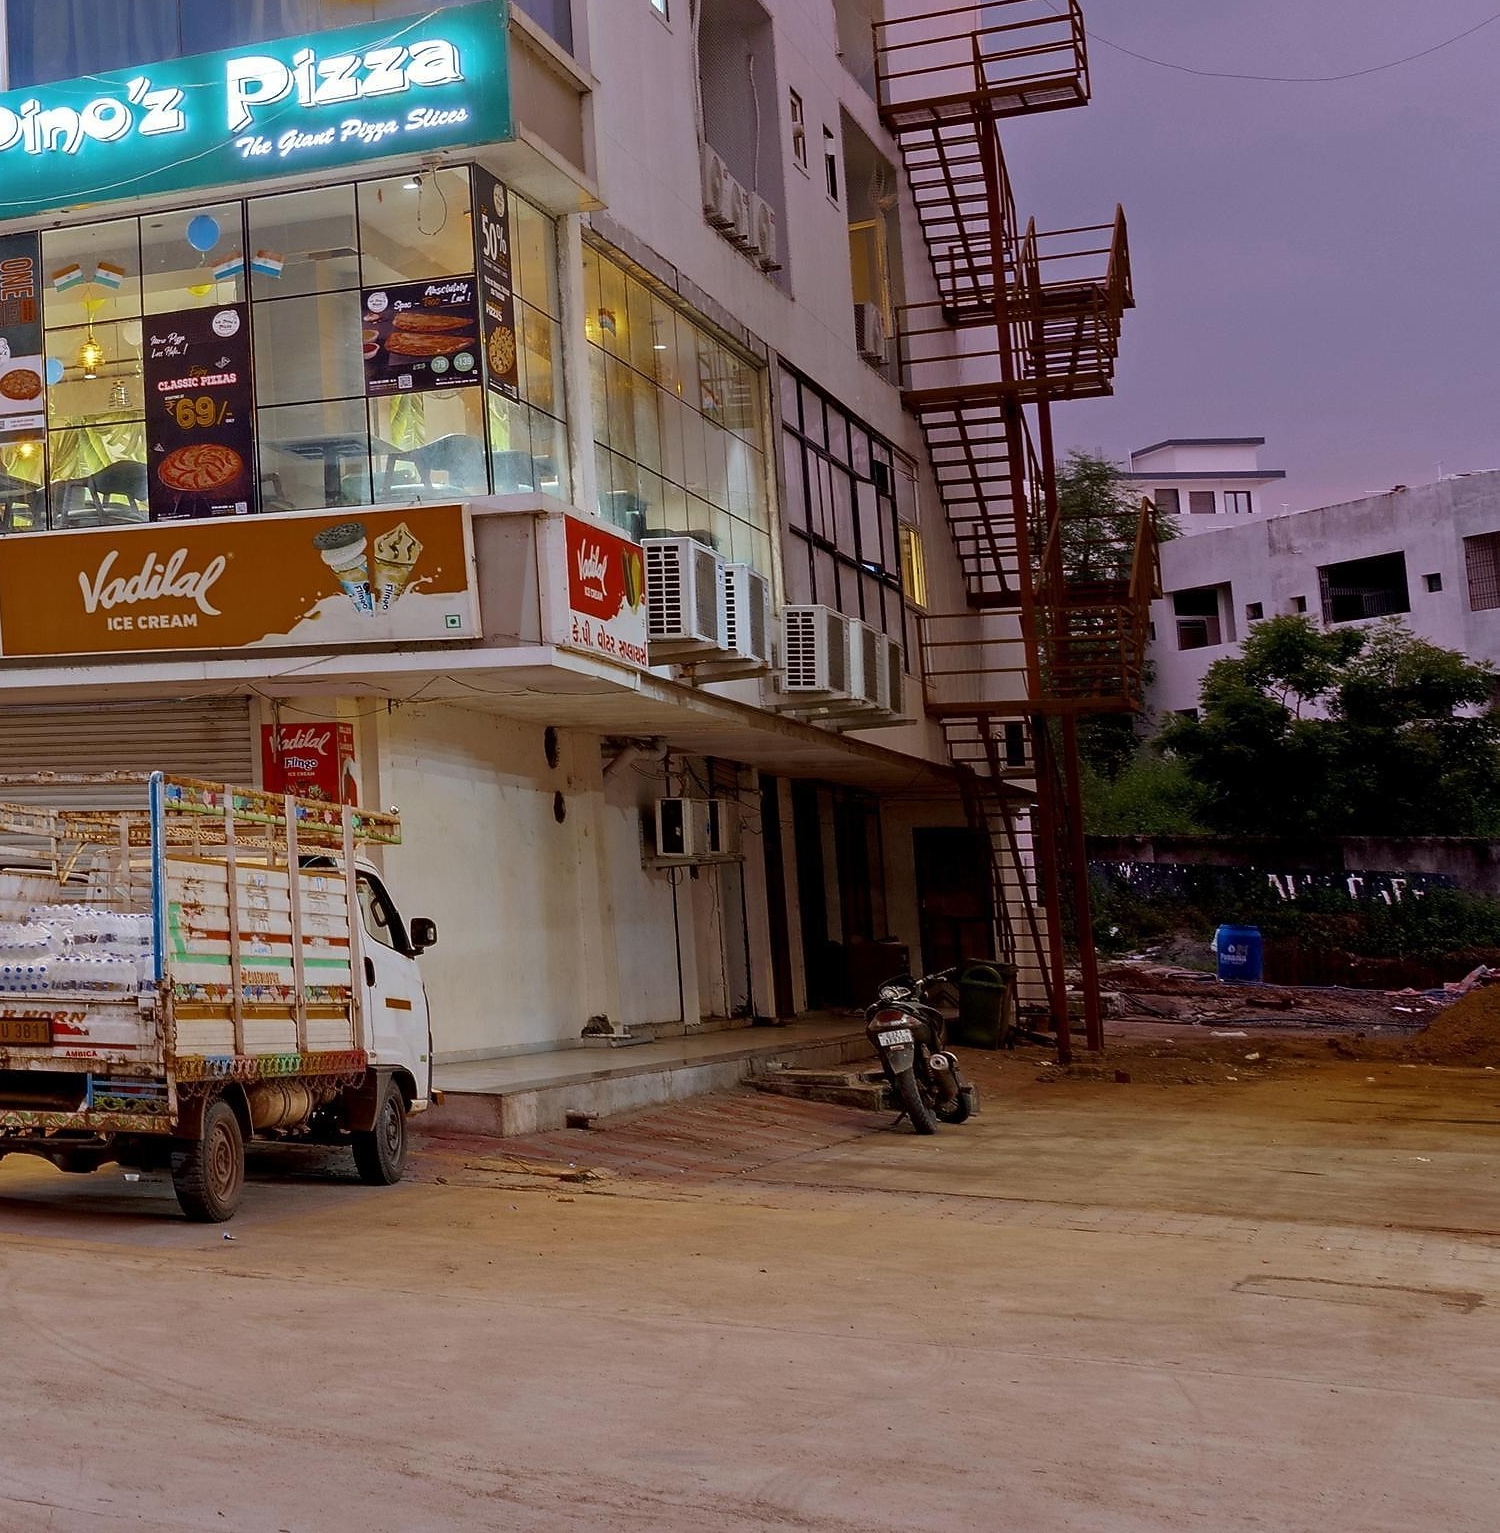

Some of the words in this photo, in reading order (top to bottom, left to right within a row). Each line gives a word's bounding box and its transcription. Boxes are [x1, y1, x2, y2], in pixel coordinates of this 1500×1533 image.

[225, 38, 467, 133] Pizza
[236, 135, 273, 161] The
[277, 127, 335, 157] Giant
[339, 116, 400, 149] Pizza
[403, 104, 471, 133] Slices
[481, 214, 507, 260] 50%
[0, 257, 34, 301] ONE
[157, 376, 199, 392] CLASSIC
[200, 372, 238, 387] PIZZAS
[78, 547, 228, 616] Vadilal
[353, 584, 369, 610] Flingo
[107, 618, 134, 632] ICE
[137, 613, 199, 631] CREAM
[283, 756, 319, 772] Flingo
[3, 1023, 9, 1038] U
